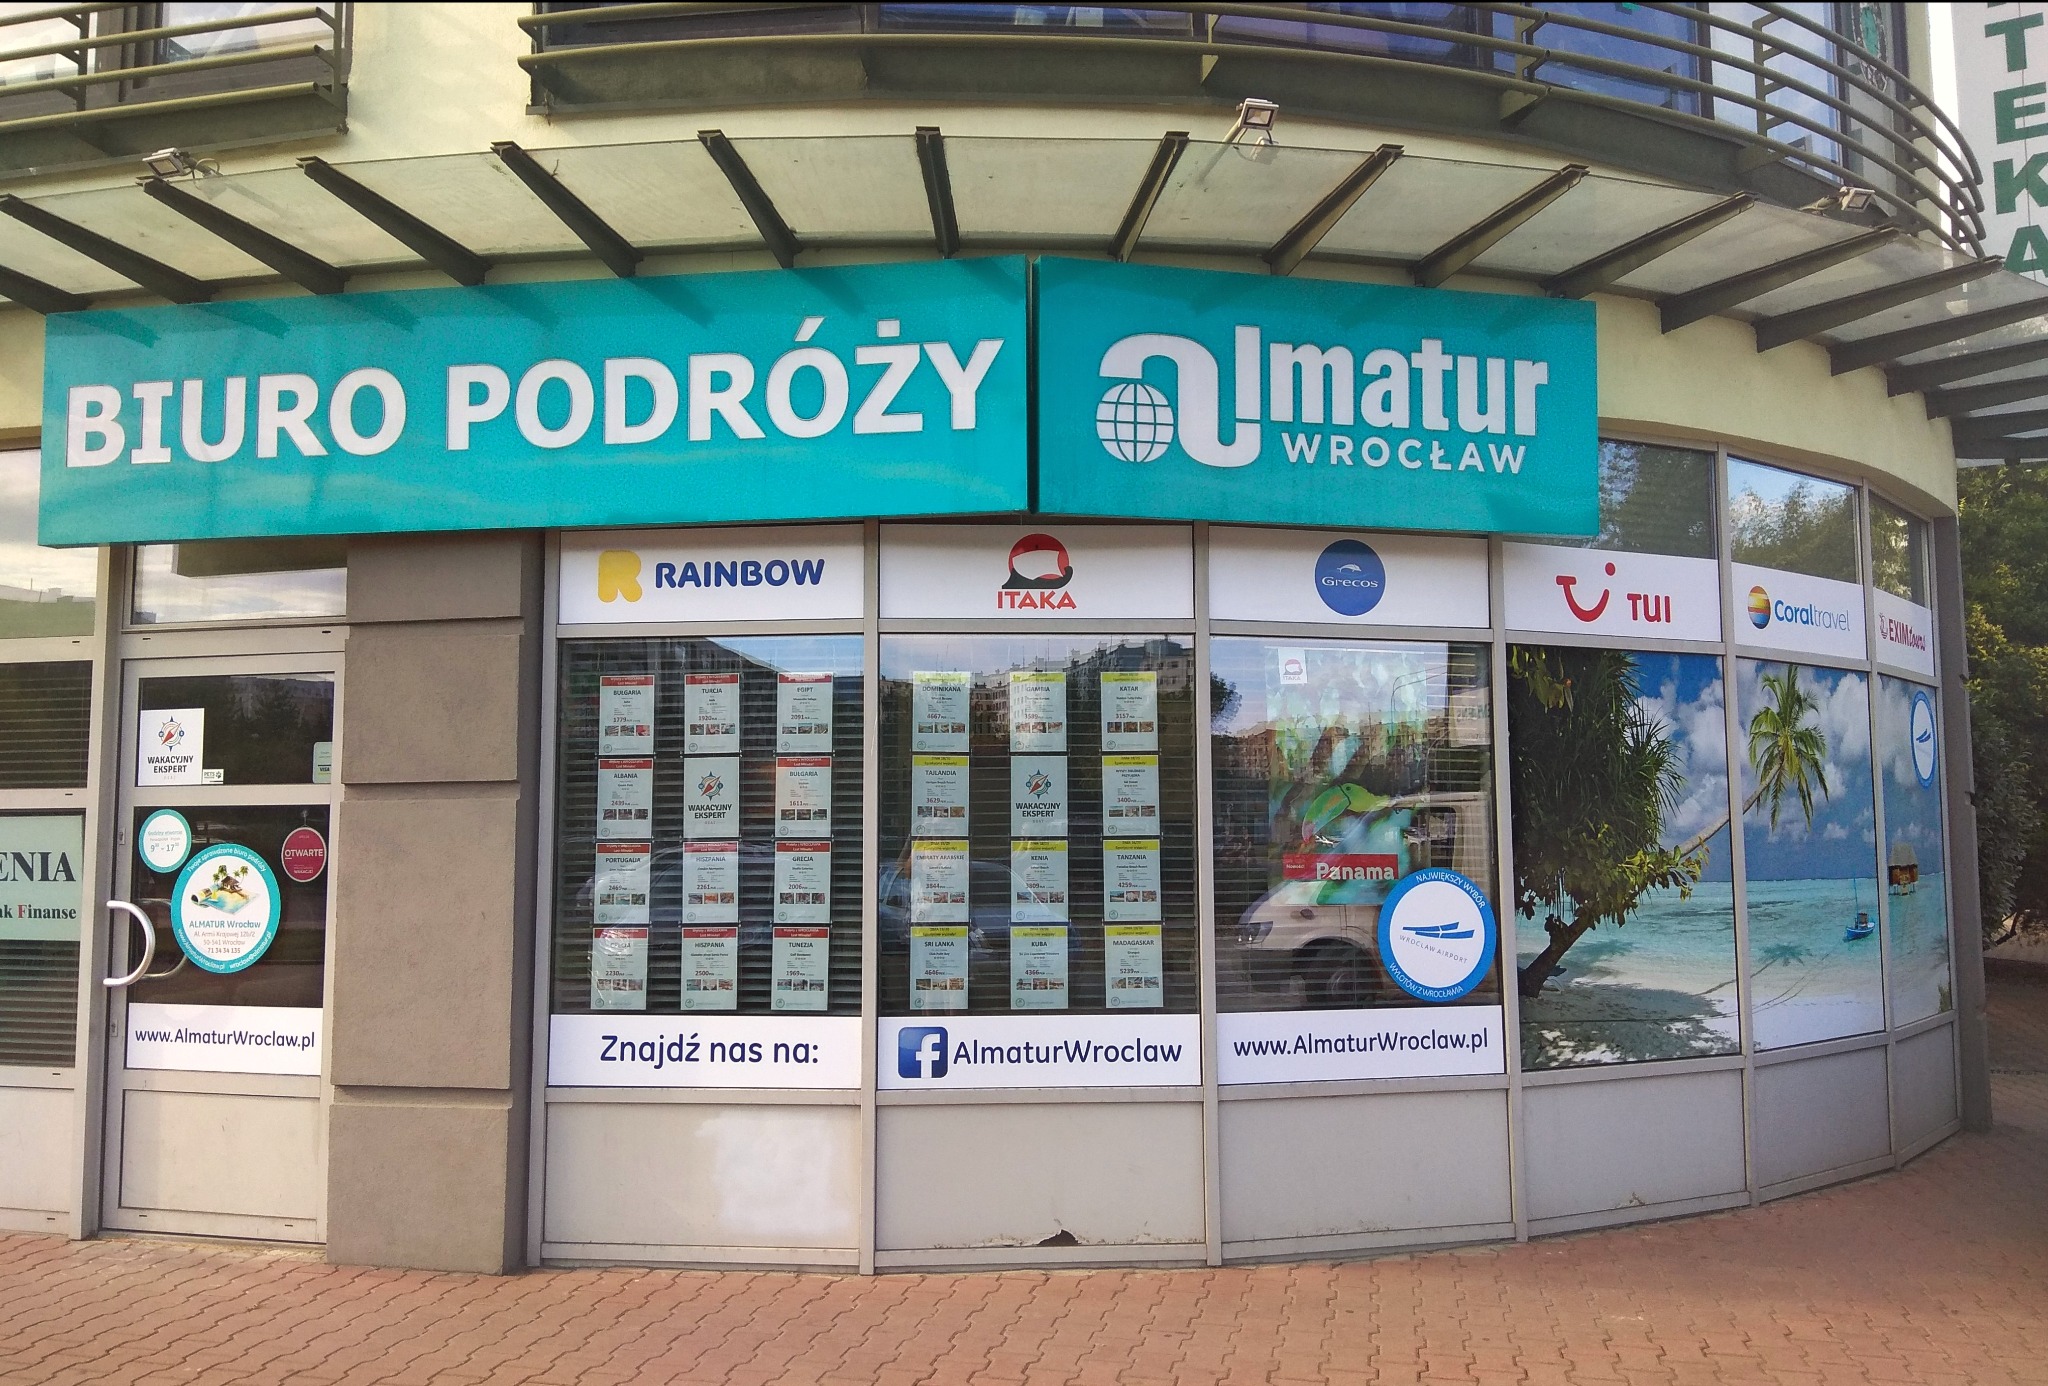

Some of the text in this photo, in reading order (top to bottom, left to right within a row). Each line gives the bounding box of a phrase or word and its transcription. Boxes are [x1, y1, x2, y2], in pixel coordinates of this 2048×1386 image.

[1984, 2, 2048, 279] TEKA
[66, 316, 1005, 469] BIURO PODRÓŻY
[1281, 433, 1526, 475] WROCŁAW
[655, 558, 825, 588] RAINBOW
[1321, 576, 1379, 588] Grecos
[996, 590, 1077, 609] ITAKA
[1627, 593, 1671, 623] TUI
[147, 755, 194, 764] WAKACYJNY
[153, 765, 187, 773] EKSPERT
[1015, 802, 1061, 810] WAKACYJNY
[284, 849, 324, 857] OTWARTE
[1316, 863, 1394, 880] Panama
[1415, 871, 1486, 909] NAJWIĘKSZY WYBÓR
[17, 904, 77, 919] Finanse
[189, 920, 260, 928] ALMATUR Wrocław
[1436, 948, 1468, 964] AIRPORT
[135, 1027, 315, 1050] www.AlmaturWroclaw.pl
[1233, 1027, 1488, 1058] www.AlmaturWroclaw.pl
[599, 1034, 820, 1069] Znajdź nas na:
[953, 1038, 1183, 1066] AlmaturWroclaw
